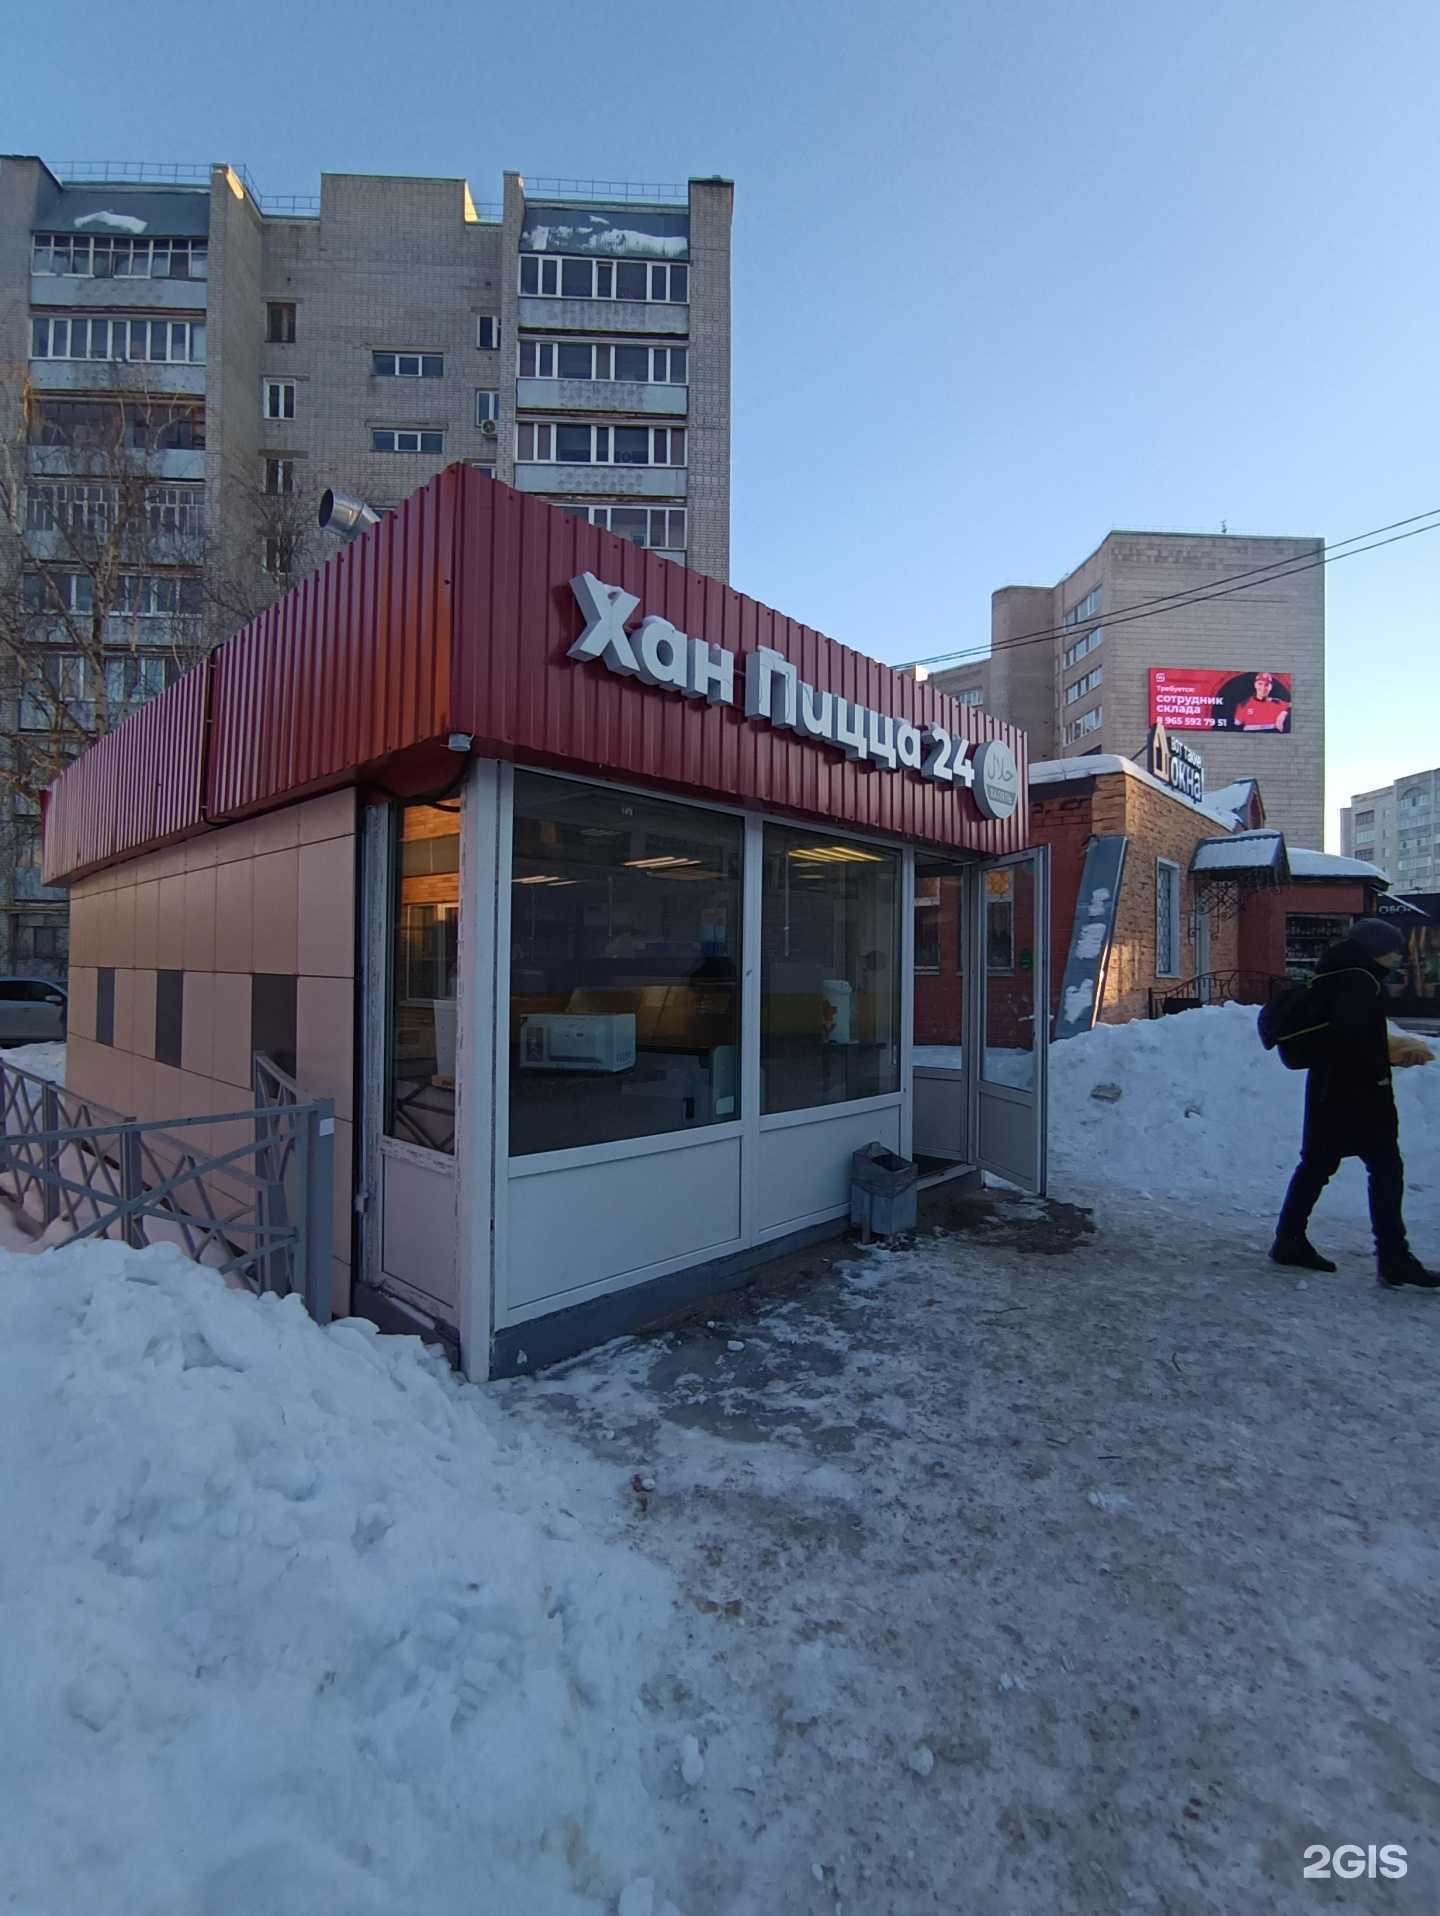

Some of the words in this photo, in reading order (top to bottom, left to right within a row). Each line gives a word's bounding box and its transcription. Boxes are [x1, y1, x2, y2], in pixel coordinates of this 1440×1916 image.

[567, 571, 734, 705] Хан
[745, 647, 921, 771] Пицца
[924, 723, 975, 788] 24
[1156, 695, 1223, 706] сотрудник
[1156, 704, 1201, 714] склада
[1165, 717, 1182, 726] 965
[1184, 717, 1201, 726] 592
[1203, 718, 1215, 727] 79
[1217, 718, 1227, 727] 51
[1171, 757, 1201, 799] окна
